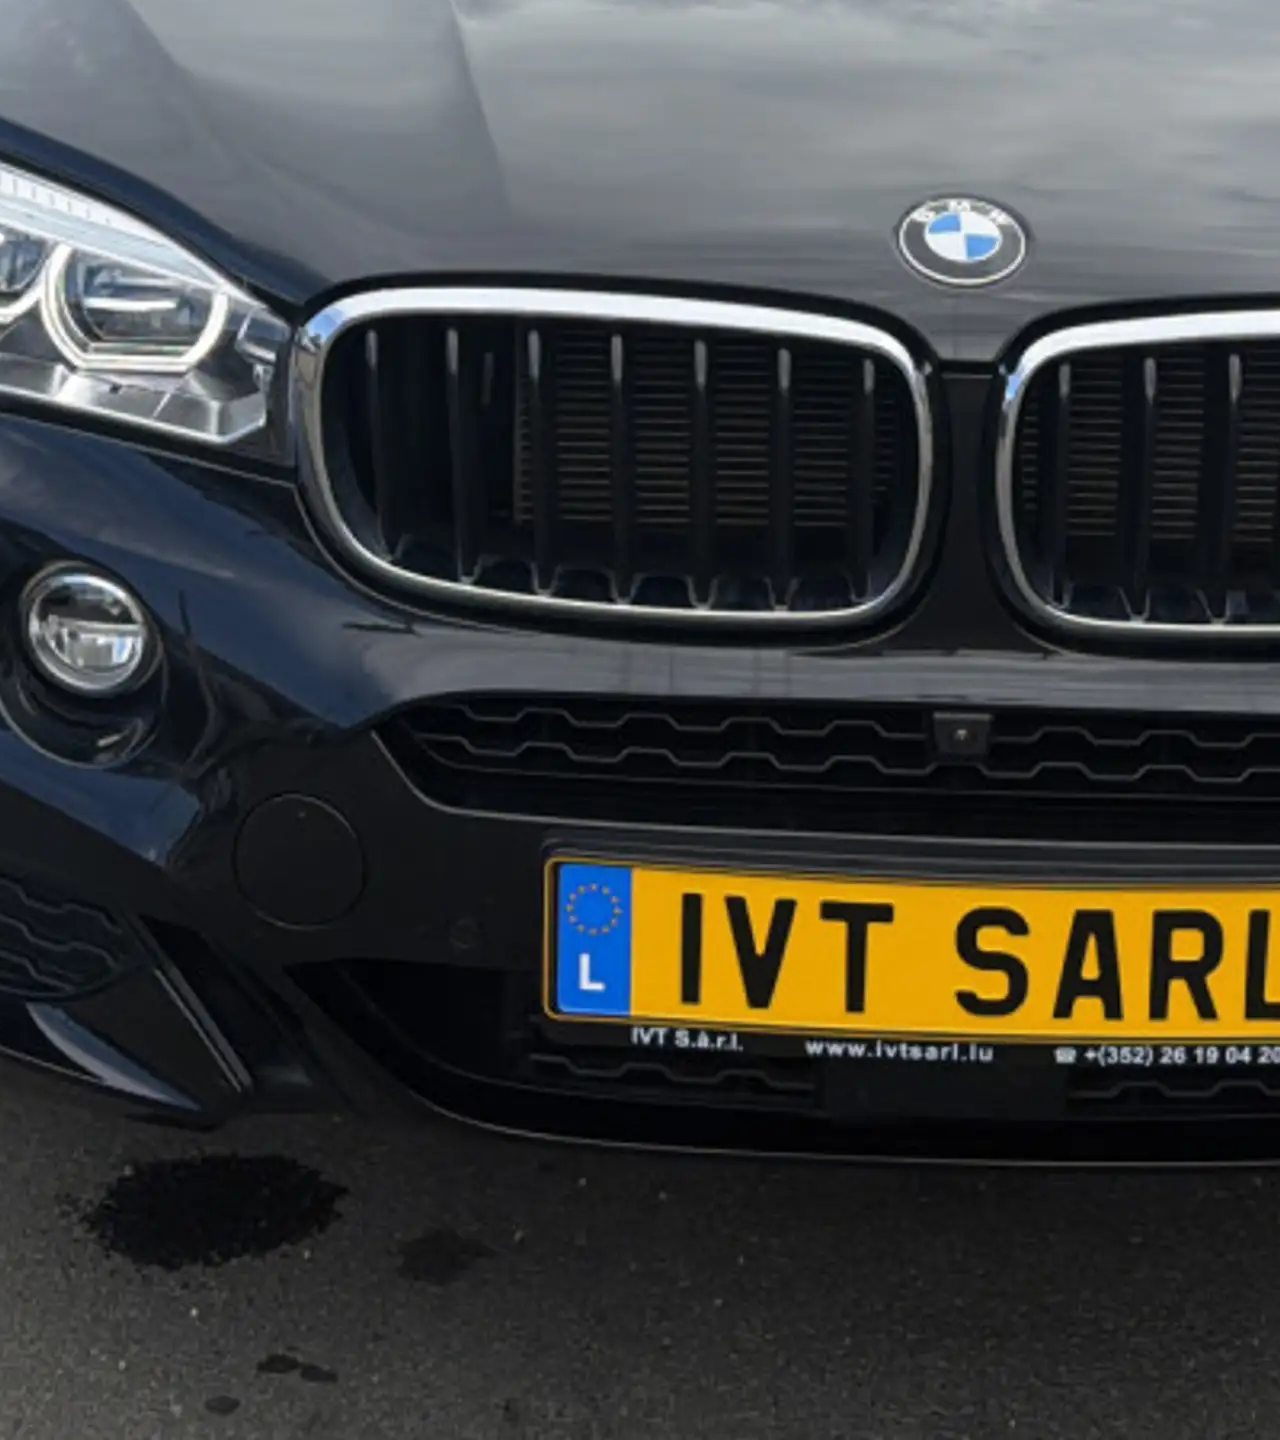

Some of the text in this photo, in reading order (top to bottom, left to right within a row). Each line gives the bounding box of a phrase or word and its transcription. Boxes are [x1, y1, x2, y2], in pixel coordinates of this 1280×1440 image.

[578, 953, 605, 993] L
[680, 891, 894, 1014] IVT
[631, 1025, 667, 1047] IVT
[805, 1038, 994, 1063] www.ivtsarl.lu
[1083, 1043, 1154, 1067] +(352)
[1159, 1045, 1187, 1065] 26
[1194, 1046, 1219, 1065] 19
[1225, 1046, 1252, 1065] 04
